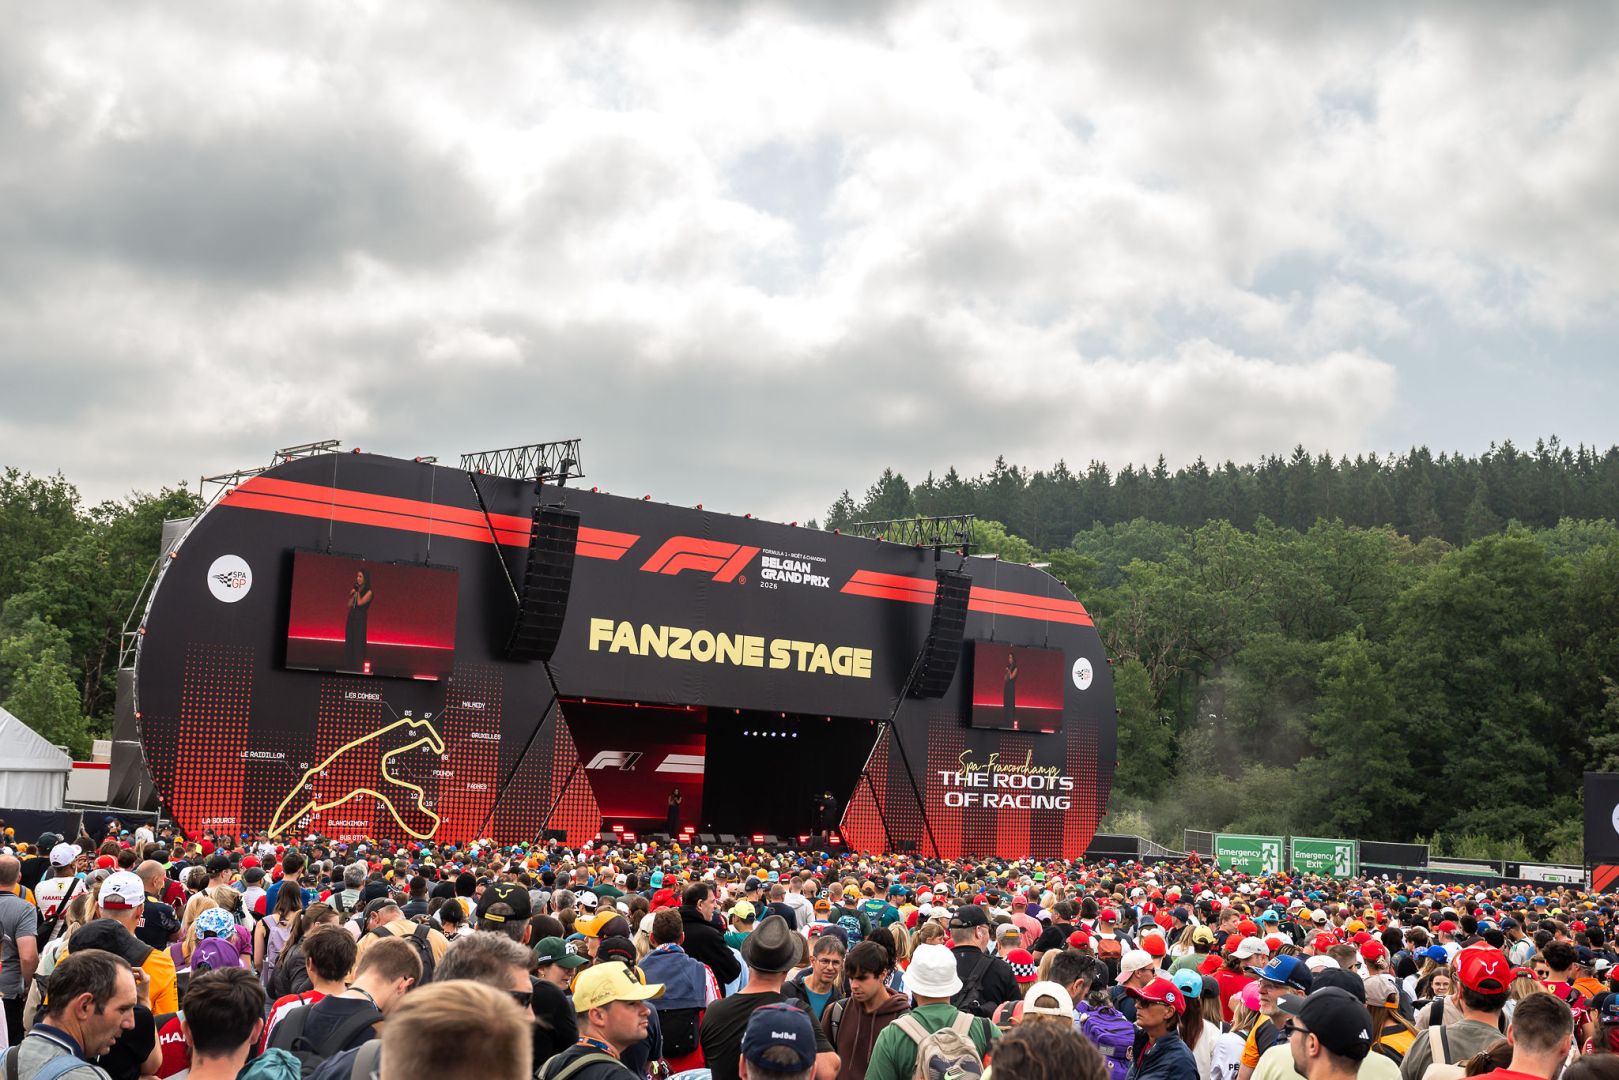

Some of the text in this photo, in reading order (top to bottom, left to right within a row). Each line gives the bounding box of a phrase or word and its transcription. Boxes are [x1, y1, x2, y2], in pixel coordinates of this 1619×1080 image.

[762, 548, 784, 556] FORMULA
[761, 556, 811, 573] BELGIAN
[232, 571, 247, 579] SPA
[761, 568, 830, 588] GRAND PRIX
[231, 578, 247, 588] GP
[760, 581, 778, 590] 2026
[589, 617, 873, 679] FANZONE STAGE
[344, 691, 380, 700] LES COMBES
[249, 751, 285, 759] RAIDILLON
[937, 771, 1074, 791] THE ROOTS
[410, 792, 418, 800] 12
[944, 792, 1071, 810] OF RACING
[1218, 848, 1261, 857] Emergency
[1295, 851, 1334, 860] Emergency
[1231, 857, 1249, 866] Exit
[1306, 860, 1323, 868] Exit
[771, 1031, 797, 1040] Red Bull
